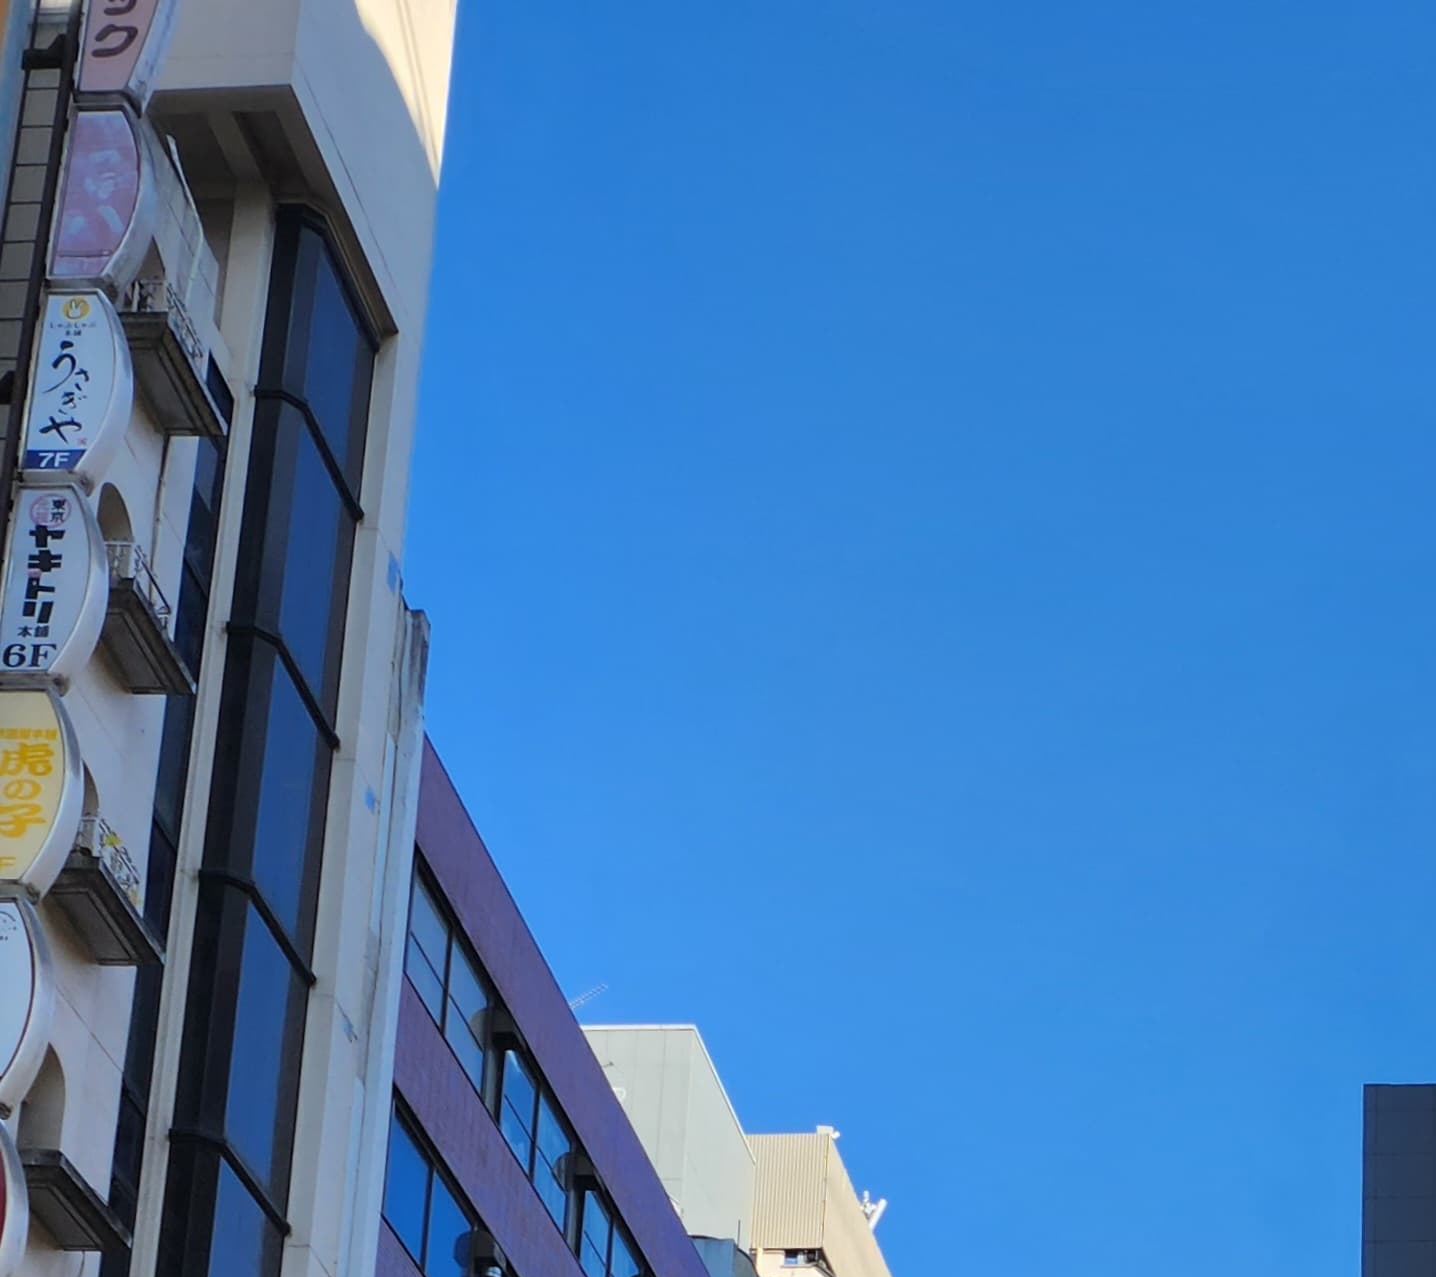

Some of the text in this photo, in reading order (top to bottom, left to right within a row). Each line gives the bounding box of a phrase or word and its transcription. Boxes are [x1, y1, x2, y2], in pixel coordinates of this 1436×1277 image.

[39, 340, 90, 445] うさぎや
[38, 452, 70, 468] 7F
[23, 524, 66, 624] ヤキトリ
[3, 643, 57, 668] 6F
